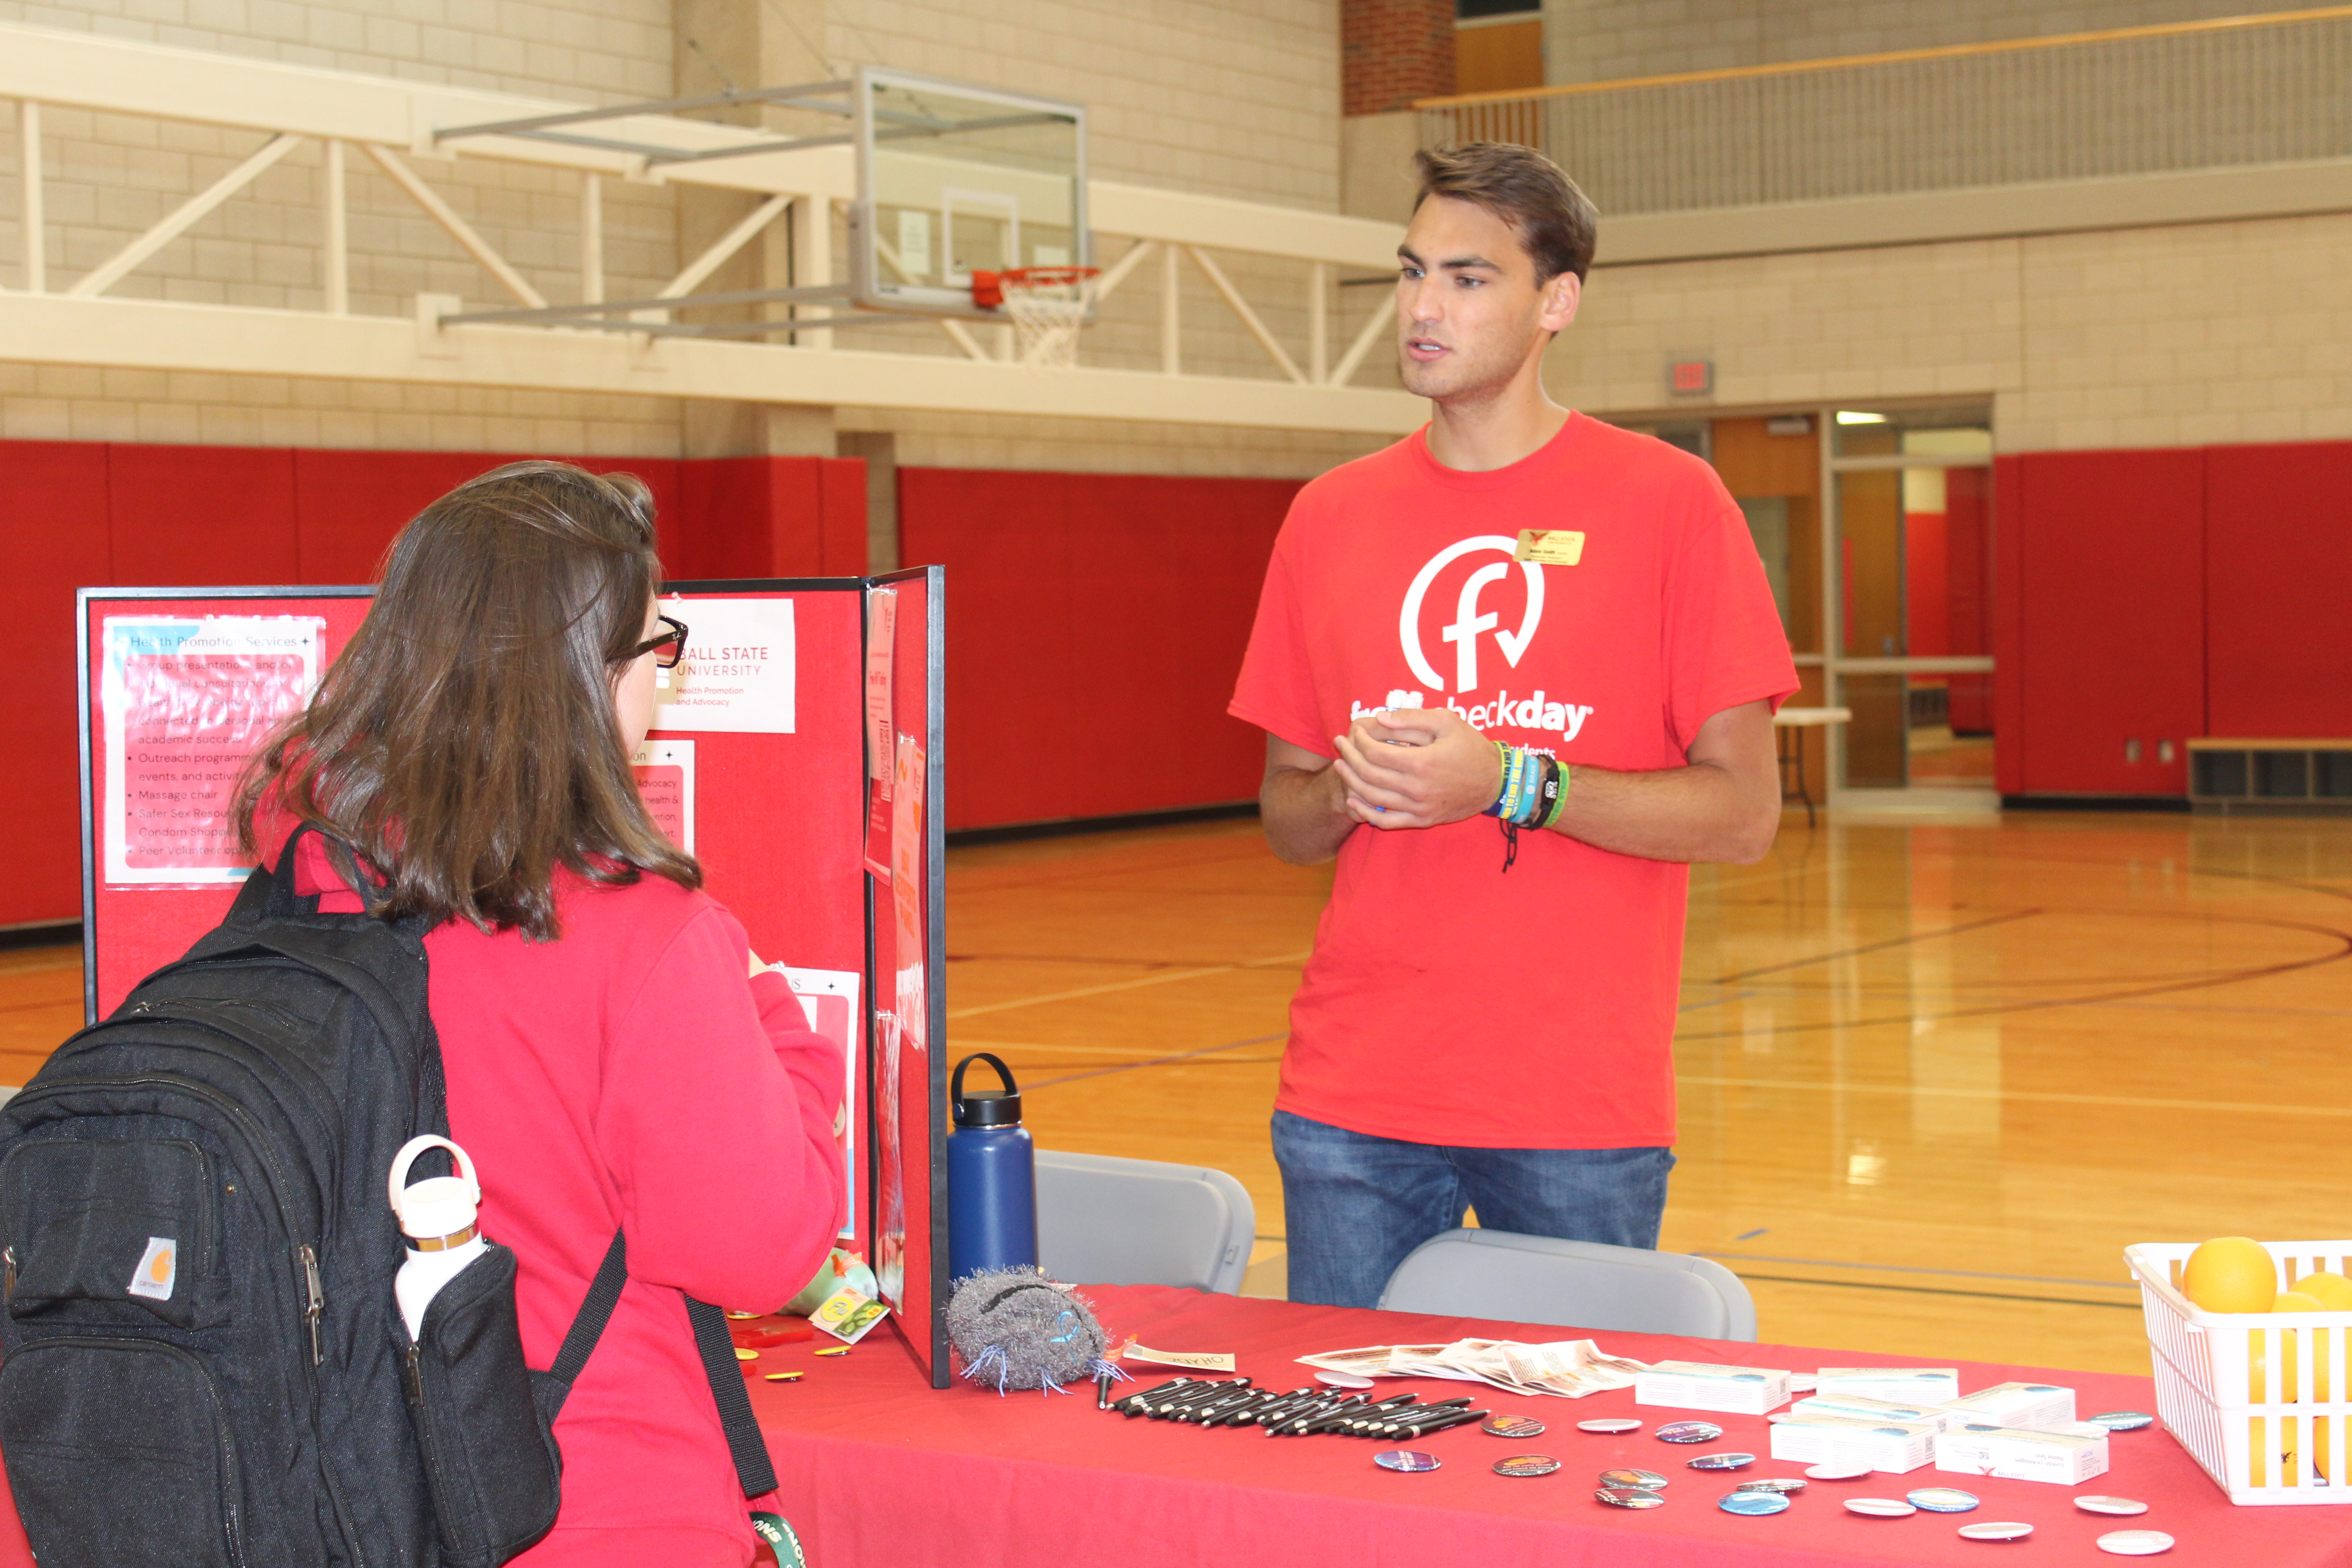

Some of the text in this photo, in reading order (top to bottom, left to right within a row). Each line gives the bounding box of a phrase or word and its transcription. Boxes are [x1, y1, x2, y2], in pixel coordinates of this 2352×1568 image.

[177, 637, 240, 646] Promotion
[248, 637, 297, 646] Services
[680, 647, 768, 660] BALL STATE
[676, 666, 761, 676] UNIVERSITY
[692, 698, 730, 707] Advocacy
[138, 716, 198, 725] connected
[138, 735, 192, 744] academic
[138, 753, 250, 764] Outreach programm
[138, 773, 240, 781] events, and activit
[637, 780, 677, 789] Advocacy
[139, 790, 218, 801] Massage chair
[645, 796, 670, 804] health
[139, 809, 229, 818] Safer Sex Resou
[139, 828, 229, 838] Condom Shopp
[139, 846, 164, 855] Peer
[167, 846, 221, 855] Volunteer
[753, 1520, 782, 1544] ONS
